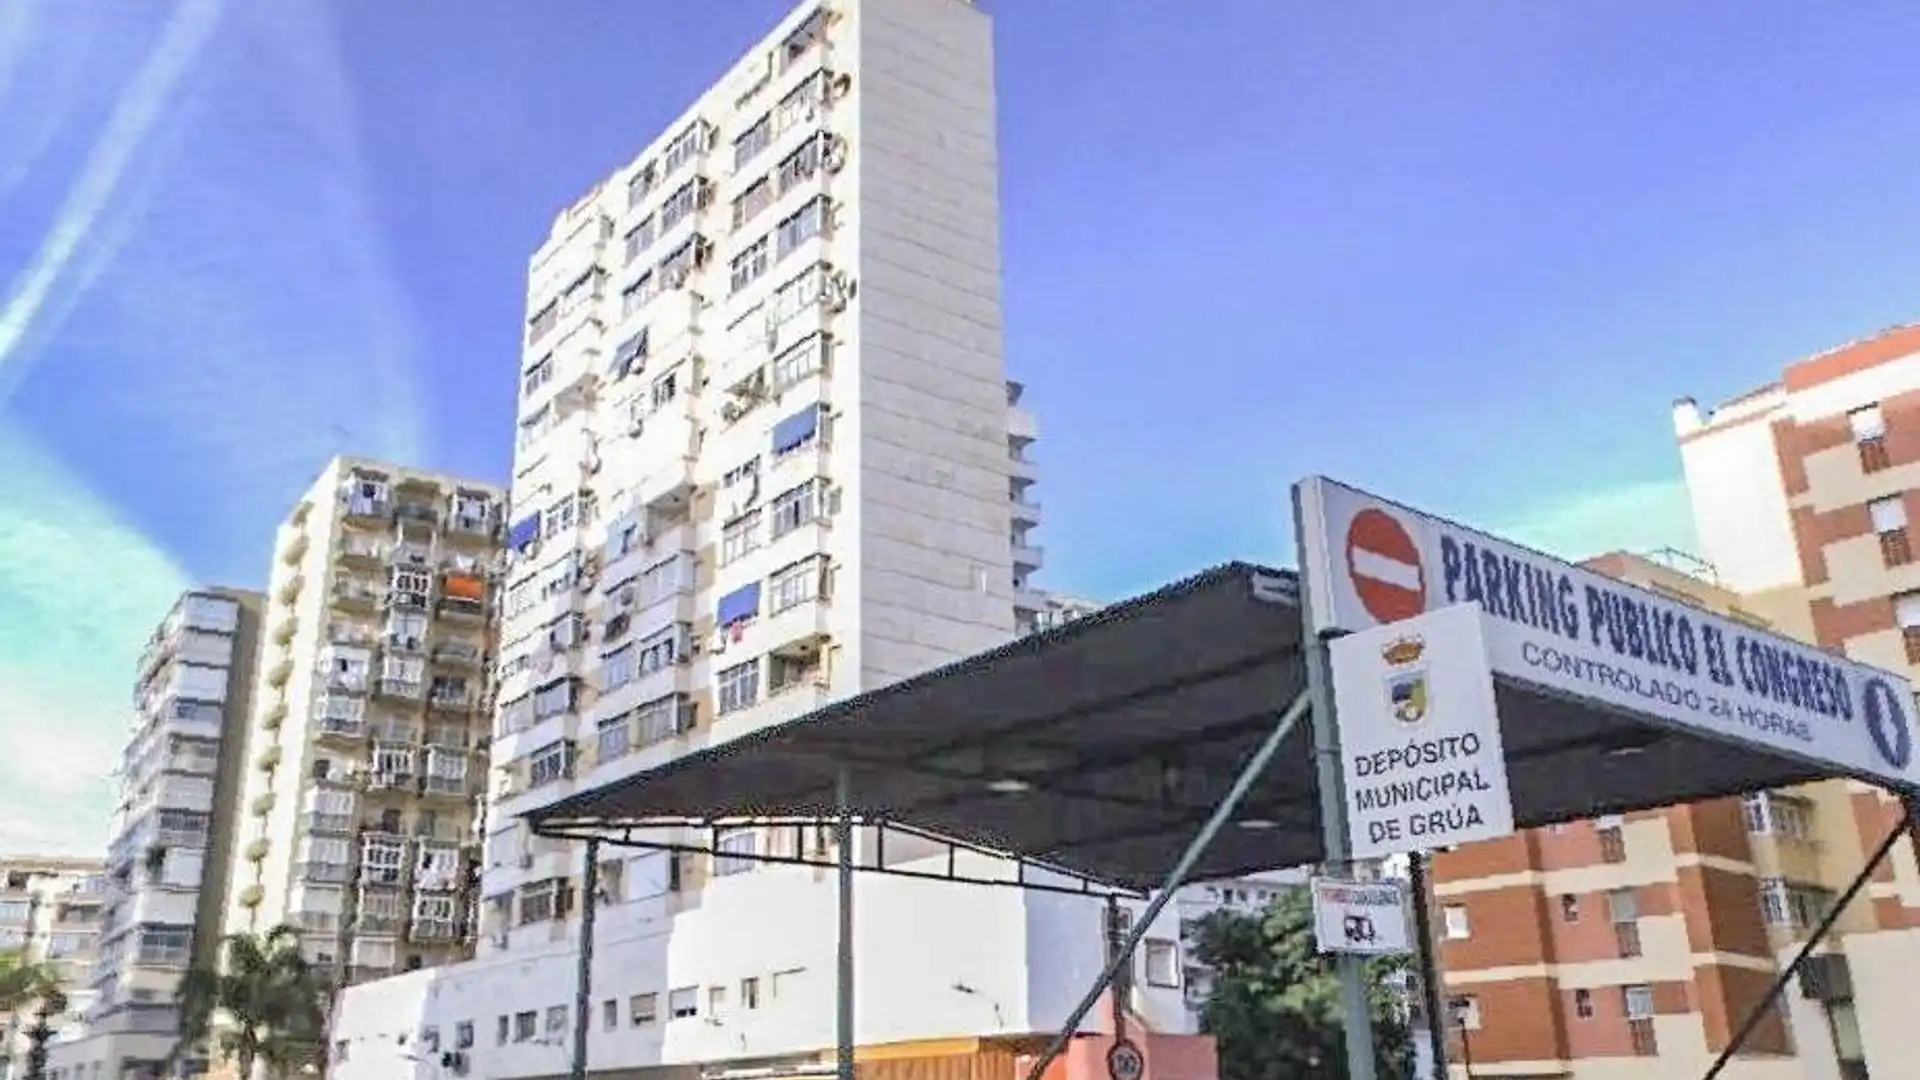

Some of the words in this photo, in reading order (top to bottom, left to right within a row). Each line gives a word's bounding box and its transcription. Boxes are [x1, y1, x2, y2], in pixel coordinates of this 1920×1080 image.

[1441, 535, 1579, 640] PARKING
[1585, 584, 1697, 675] PUBLICO
[1702, 624, 1734, 686] EL
[1736, 635, 1853, 721] CONGRESO
[1522, 641, 1699, 711] CONTROLADO
[1708, 697, 1732, 720] 24
[1737, 704, 1813, 742] HORAS
[1355, 732, 1480, 777] DEPÓSITO
[1355, 769, 1491, 813] MUNICIPAL
[1369, 818, 1401, 844] DE
[1410, 803, 1483, 836] GRÚA
